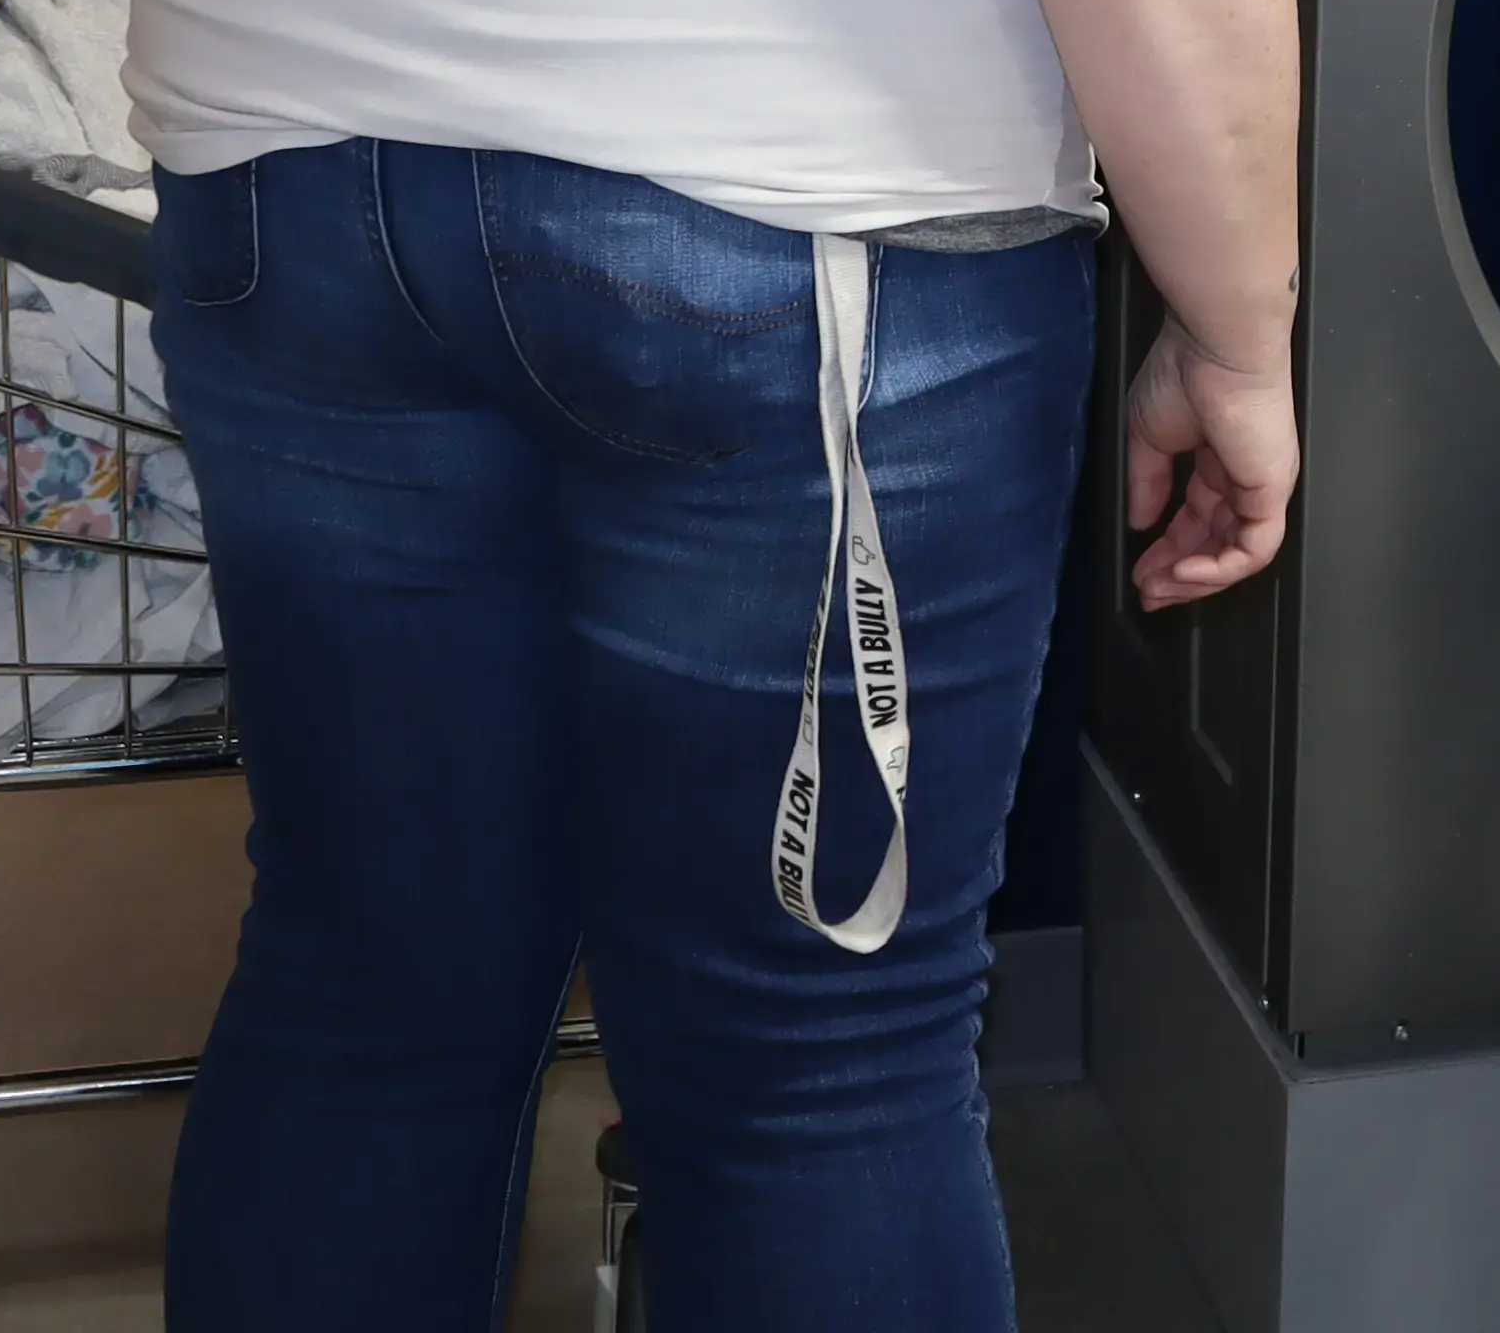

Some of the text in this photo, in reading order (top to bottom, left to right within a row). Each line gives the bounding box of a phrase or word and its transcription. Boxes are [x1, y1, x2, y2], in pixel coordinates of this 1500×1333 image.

[856, 577, 898, 730] NOT A BULLY
[789, 768, 815, 834] NOT
[780, 829, 806, 857] A
